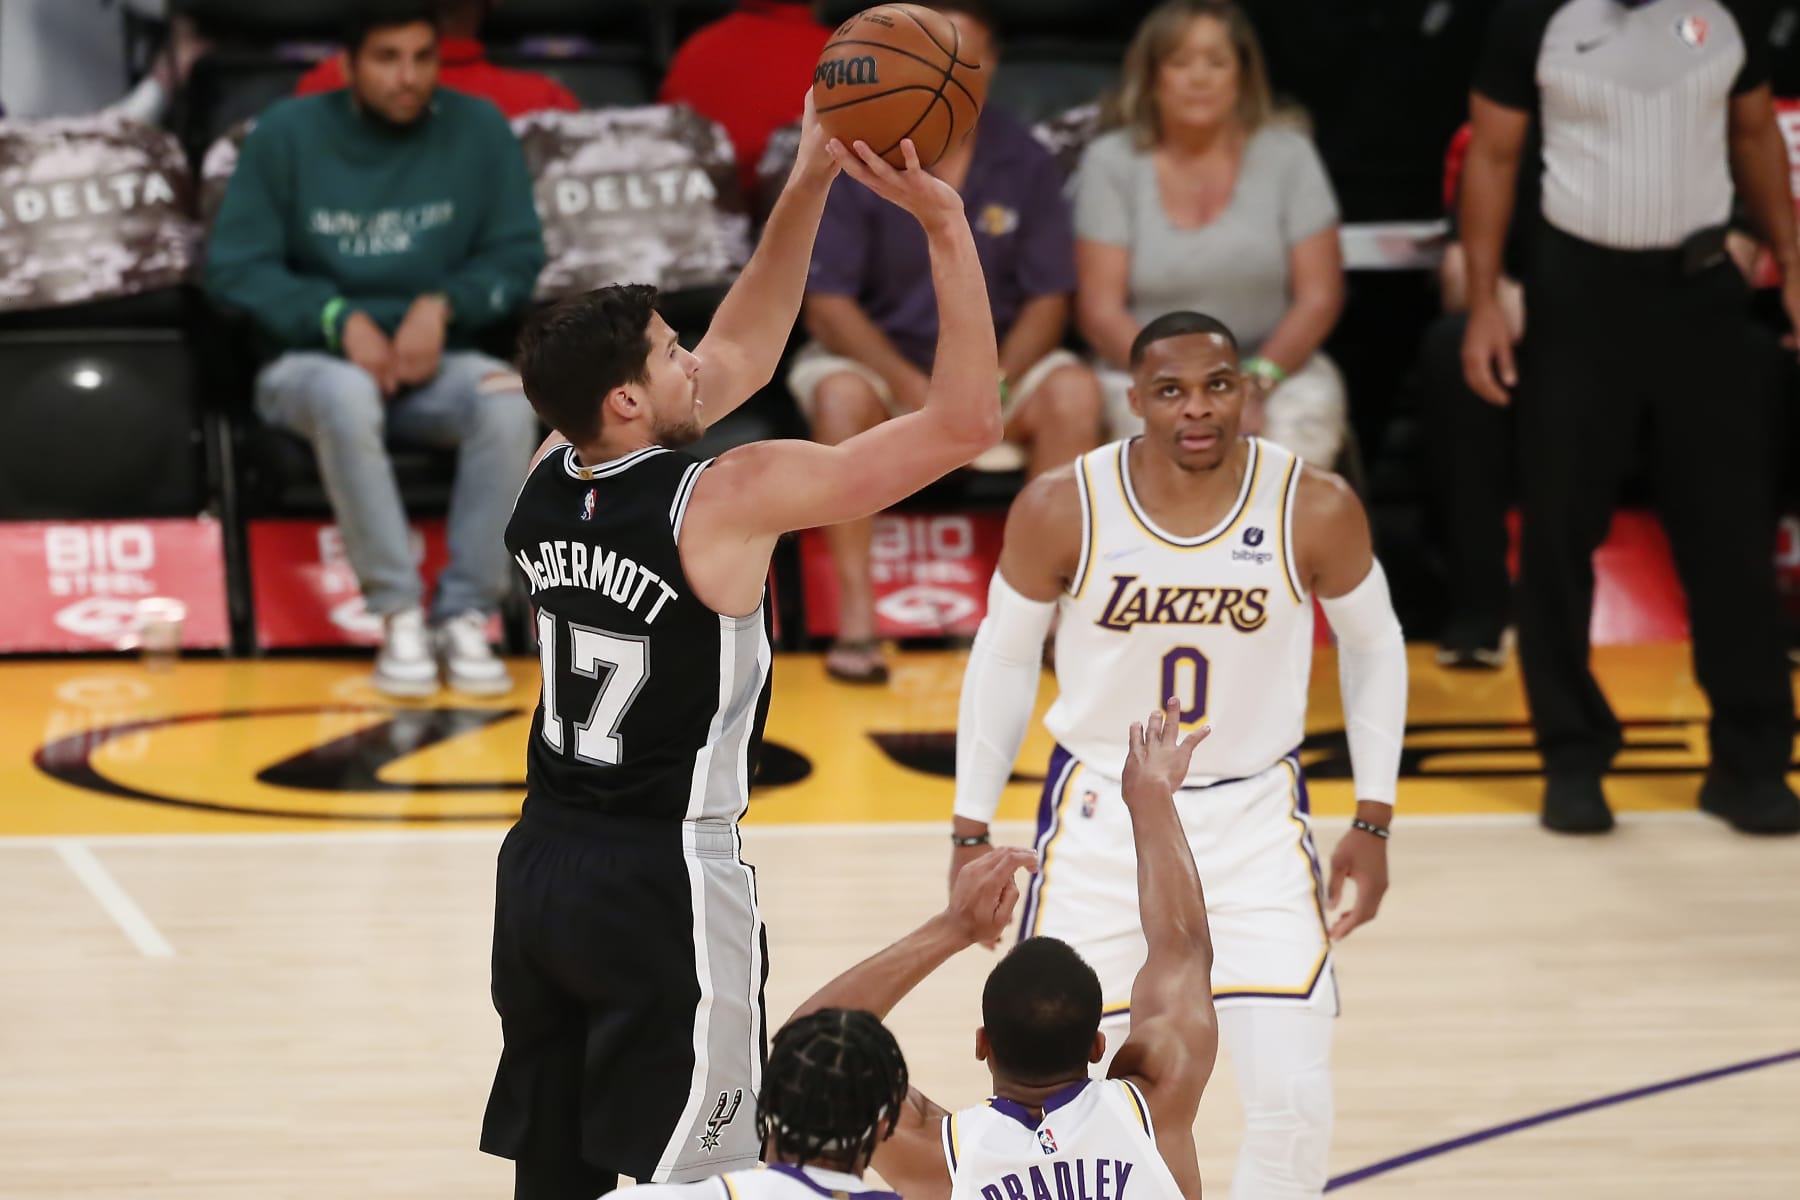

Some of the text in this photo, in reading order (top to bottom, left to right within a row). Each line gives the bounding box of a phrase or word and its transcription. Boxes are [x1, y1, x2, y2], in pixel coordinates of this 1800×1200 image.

[13, 171, 175, 224] DELTA
[555, 168, 718, 216] DELTA
[44, 524, 155, 572] BIO
[1231, 549, 1273, 565] bibigo
[514, 540, 679, 624] McDERMOTT
[1094, 574, 1269, 633] LAKERS
[536, 606, 651, 767] 17
[1160, 644, 1210, 731] 0
